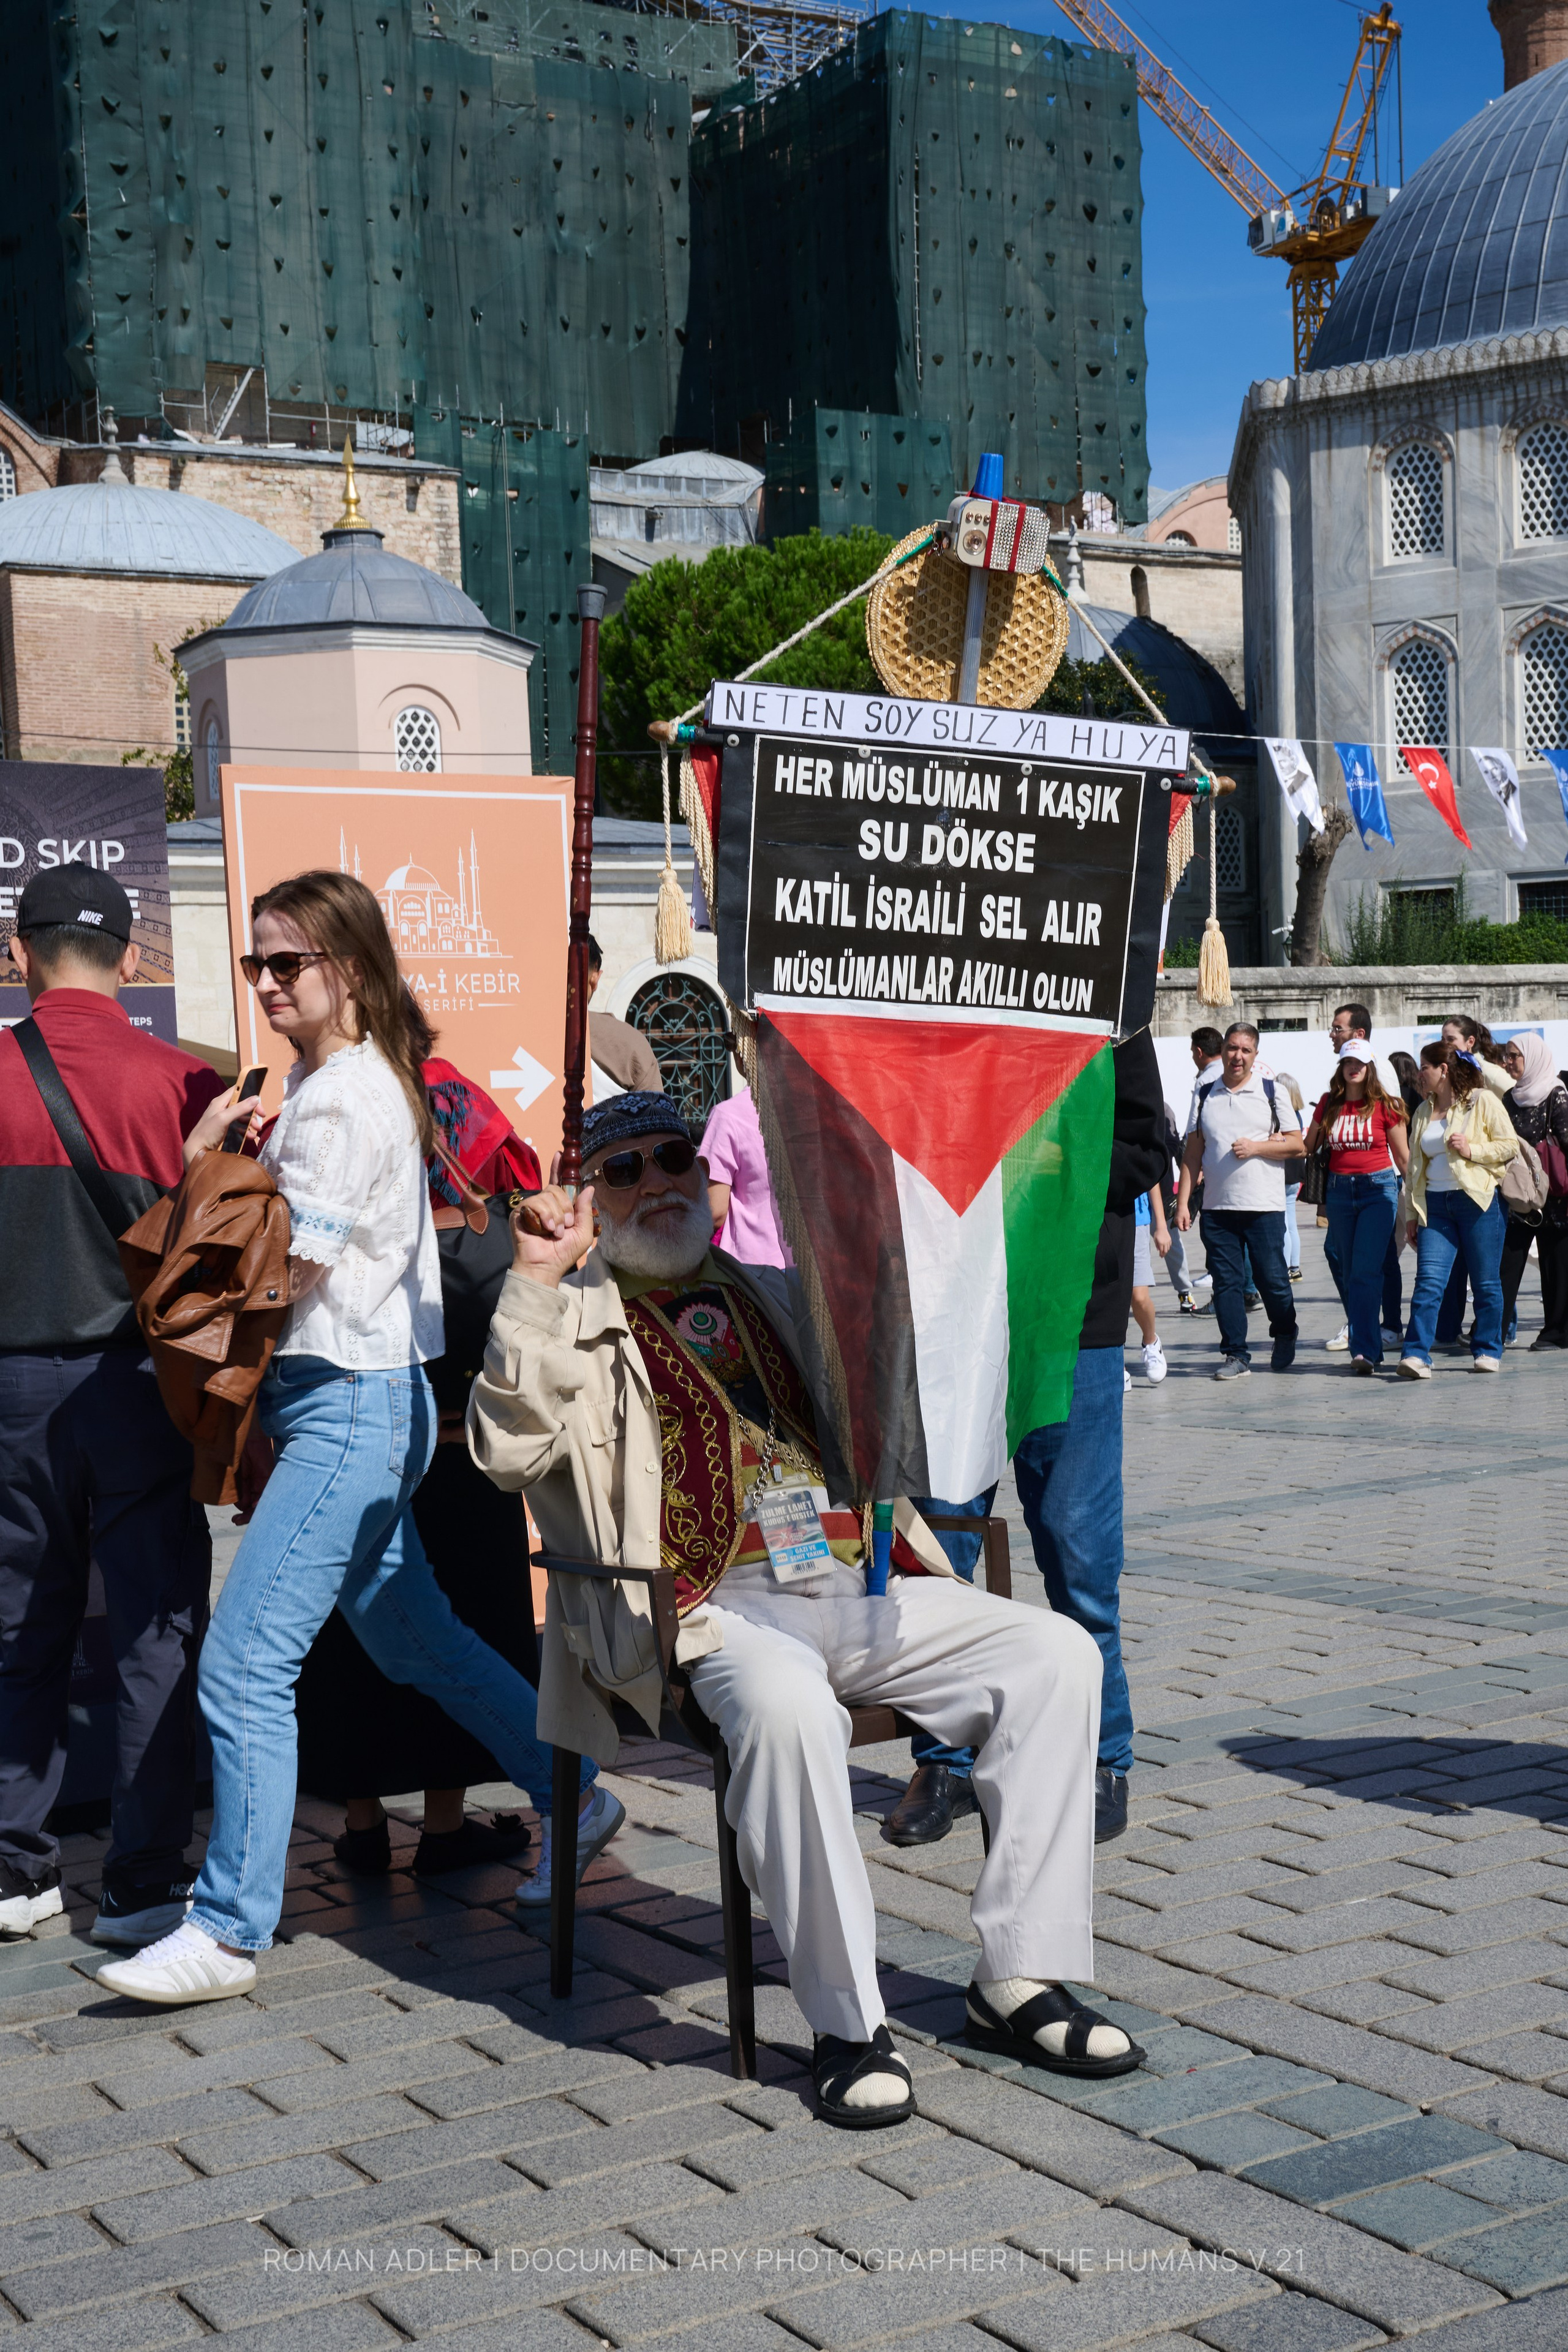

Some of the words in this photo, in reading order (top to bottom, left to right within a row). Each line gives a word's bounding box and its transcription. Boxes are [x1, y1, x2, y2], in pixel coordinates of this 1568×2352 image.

[725, 689, 845, 730] NETEN
[775, 755, 832, 797] HER
[842, 756, 1001, 812] MÜSLÜMAN
[1017, 777, 1028, 815] 1
[1038, 780, 1123, 830] KAŞIK
[38, 839, 125, 871] SKIP
[858, 819, 909, 862] SU
[921, 818, 1036, 873] DÖKSE
[77, 910, 104, 925] NIKE
[775, 872, 856, 927] KATİL
[865, 874, 966, 936] İSRAİLİ
[979, 894, 1027, 940] SEL
[1041, 900, 1102, 946] ALIR
[455, 969, 521, 993] KEBİR
[773, 949, 954, 1003] MÜSLÜMANLAR
[956, 959, 1028, 1008] AKILLI
[1033, 972, 1094, 1012] OLUN
[423, 997, 474, 1014] ŞERİFİ
[1329, 1115, 1373, 1143] WHY!
[1345, 1142, 1372, 1152] TODAY
[761, 1506, 788, 1519] ZULME
[788, 1501, 813, 1513] LANET
[791, 1510, 815, 1521] DESTEK
